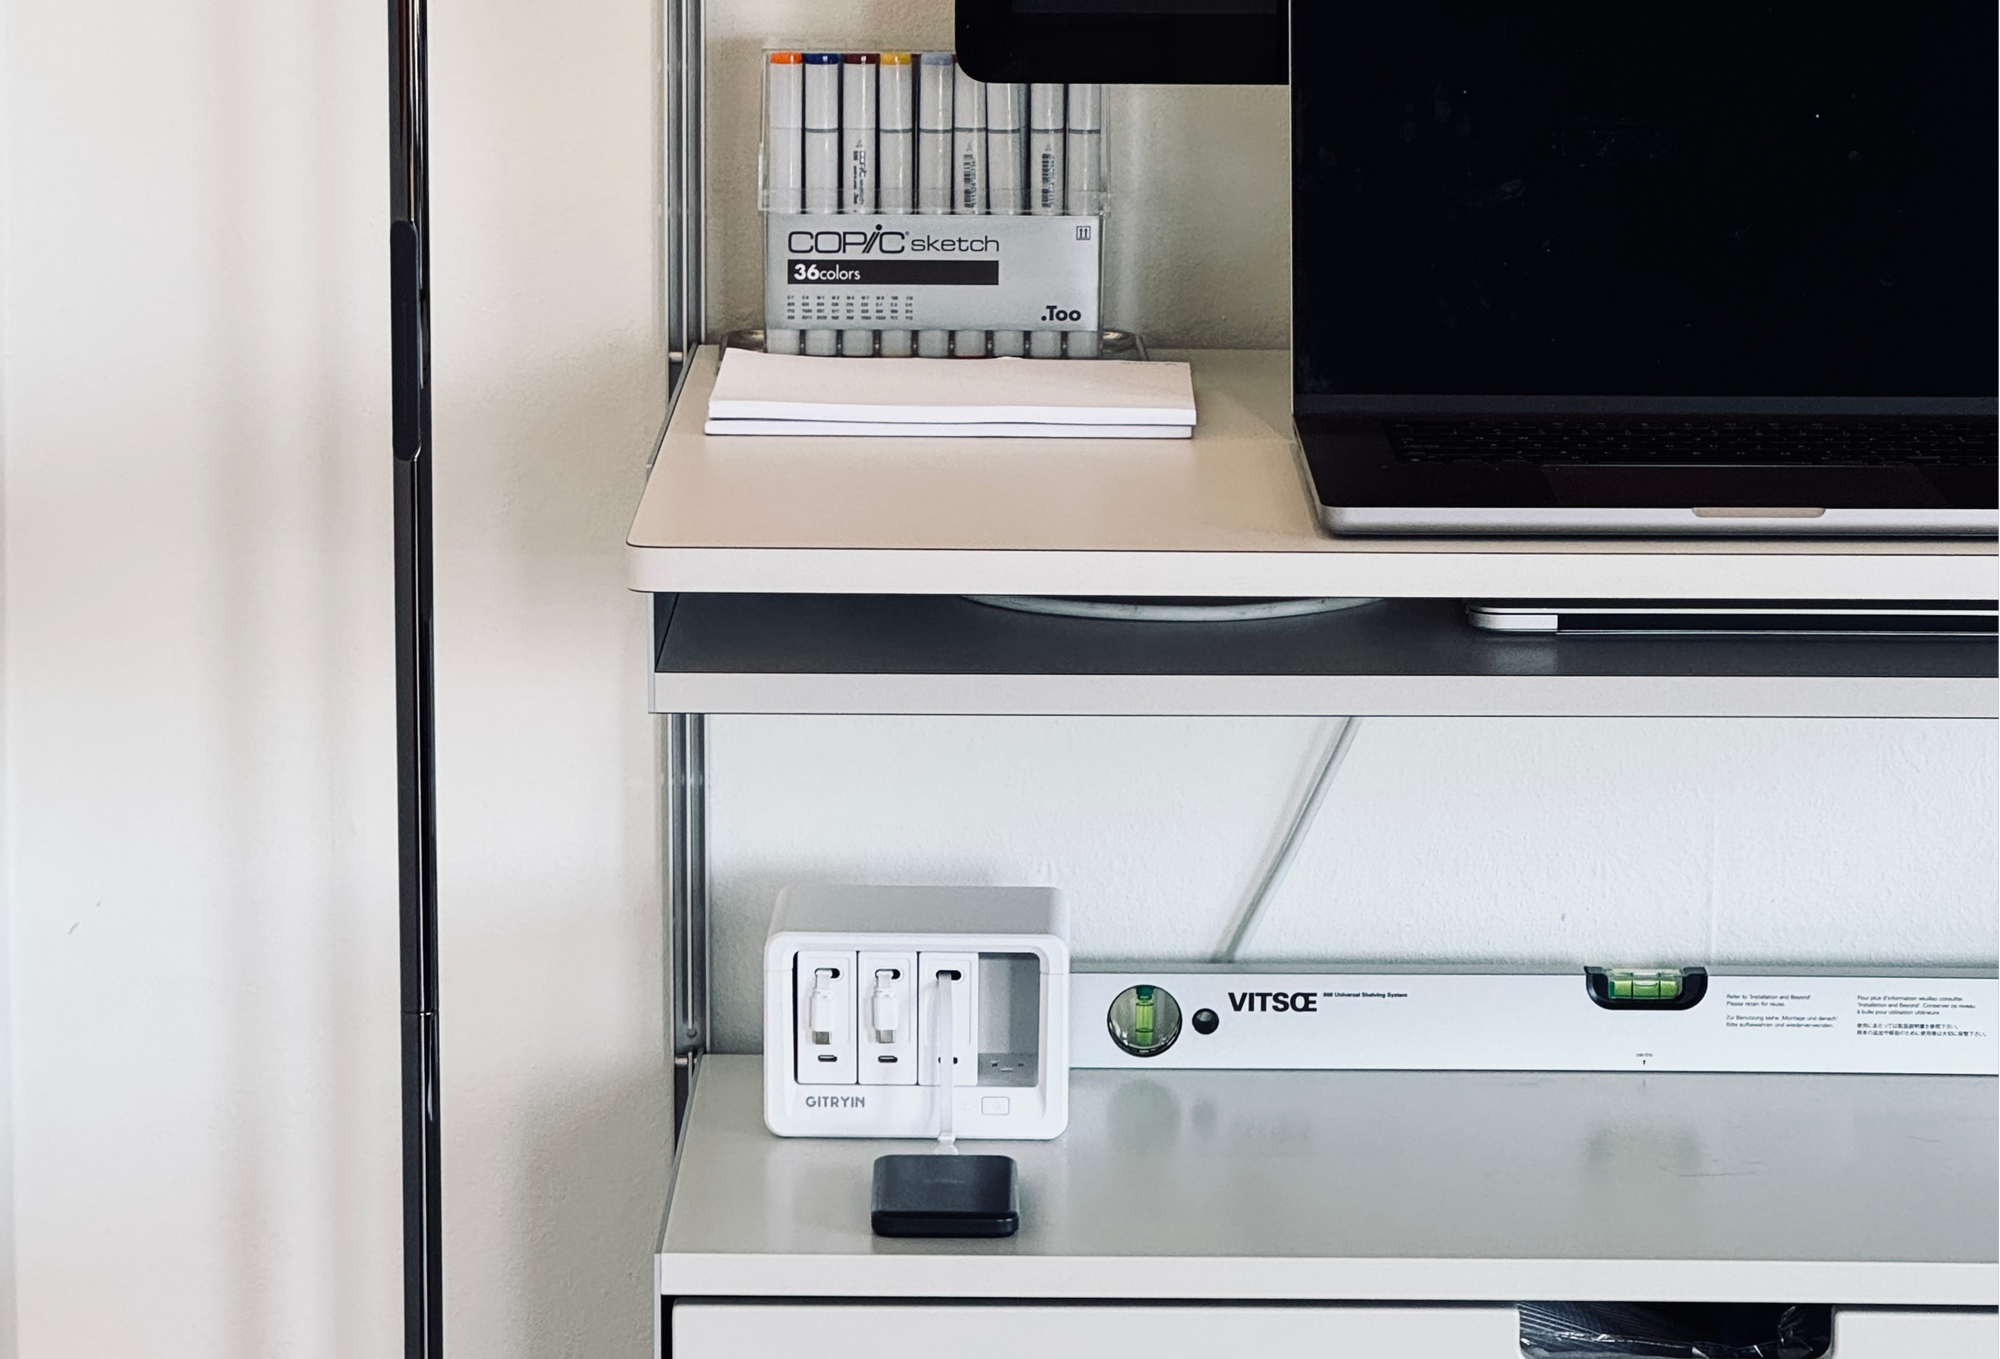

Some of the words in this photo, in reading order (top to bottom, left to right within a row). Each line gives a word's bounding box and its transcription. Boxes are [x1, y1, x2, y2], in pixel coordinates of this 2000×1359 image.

[910, 234, 1000, 253] sketch
[794, 263, 861, 281] 36colors
[1040, 305, 1082, 322] .Too
[1228, 992, 1318, 1012] VITSŒ
[805, 1096, 866, 1108] GITRYIN
